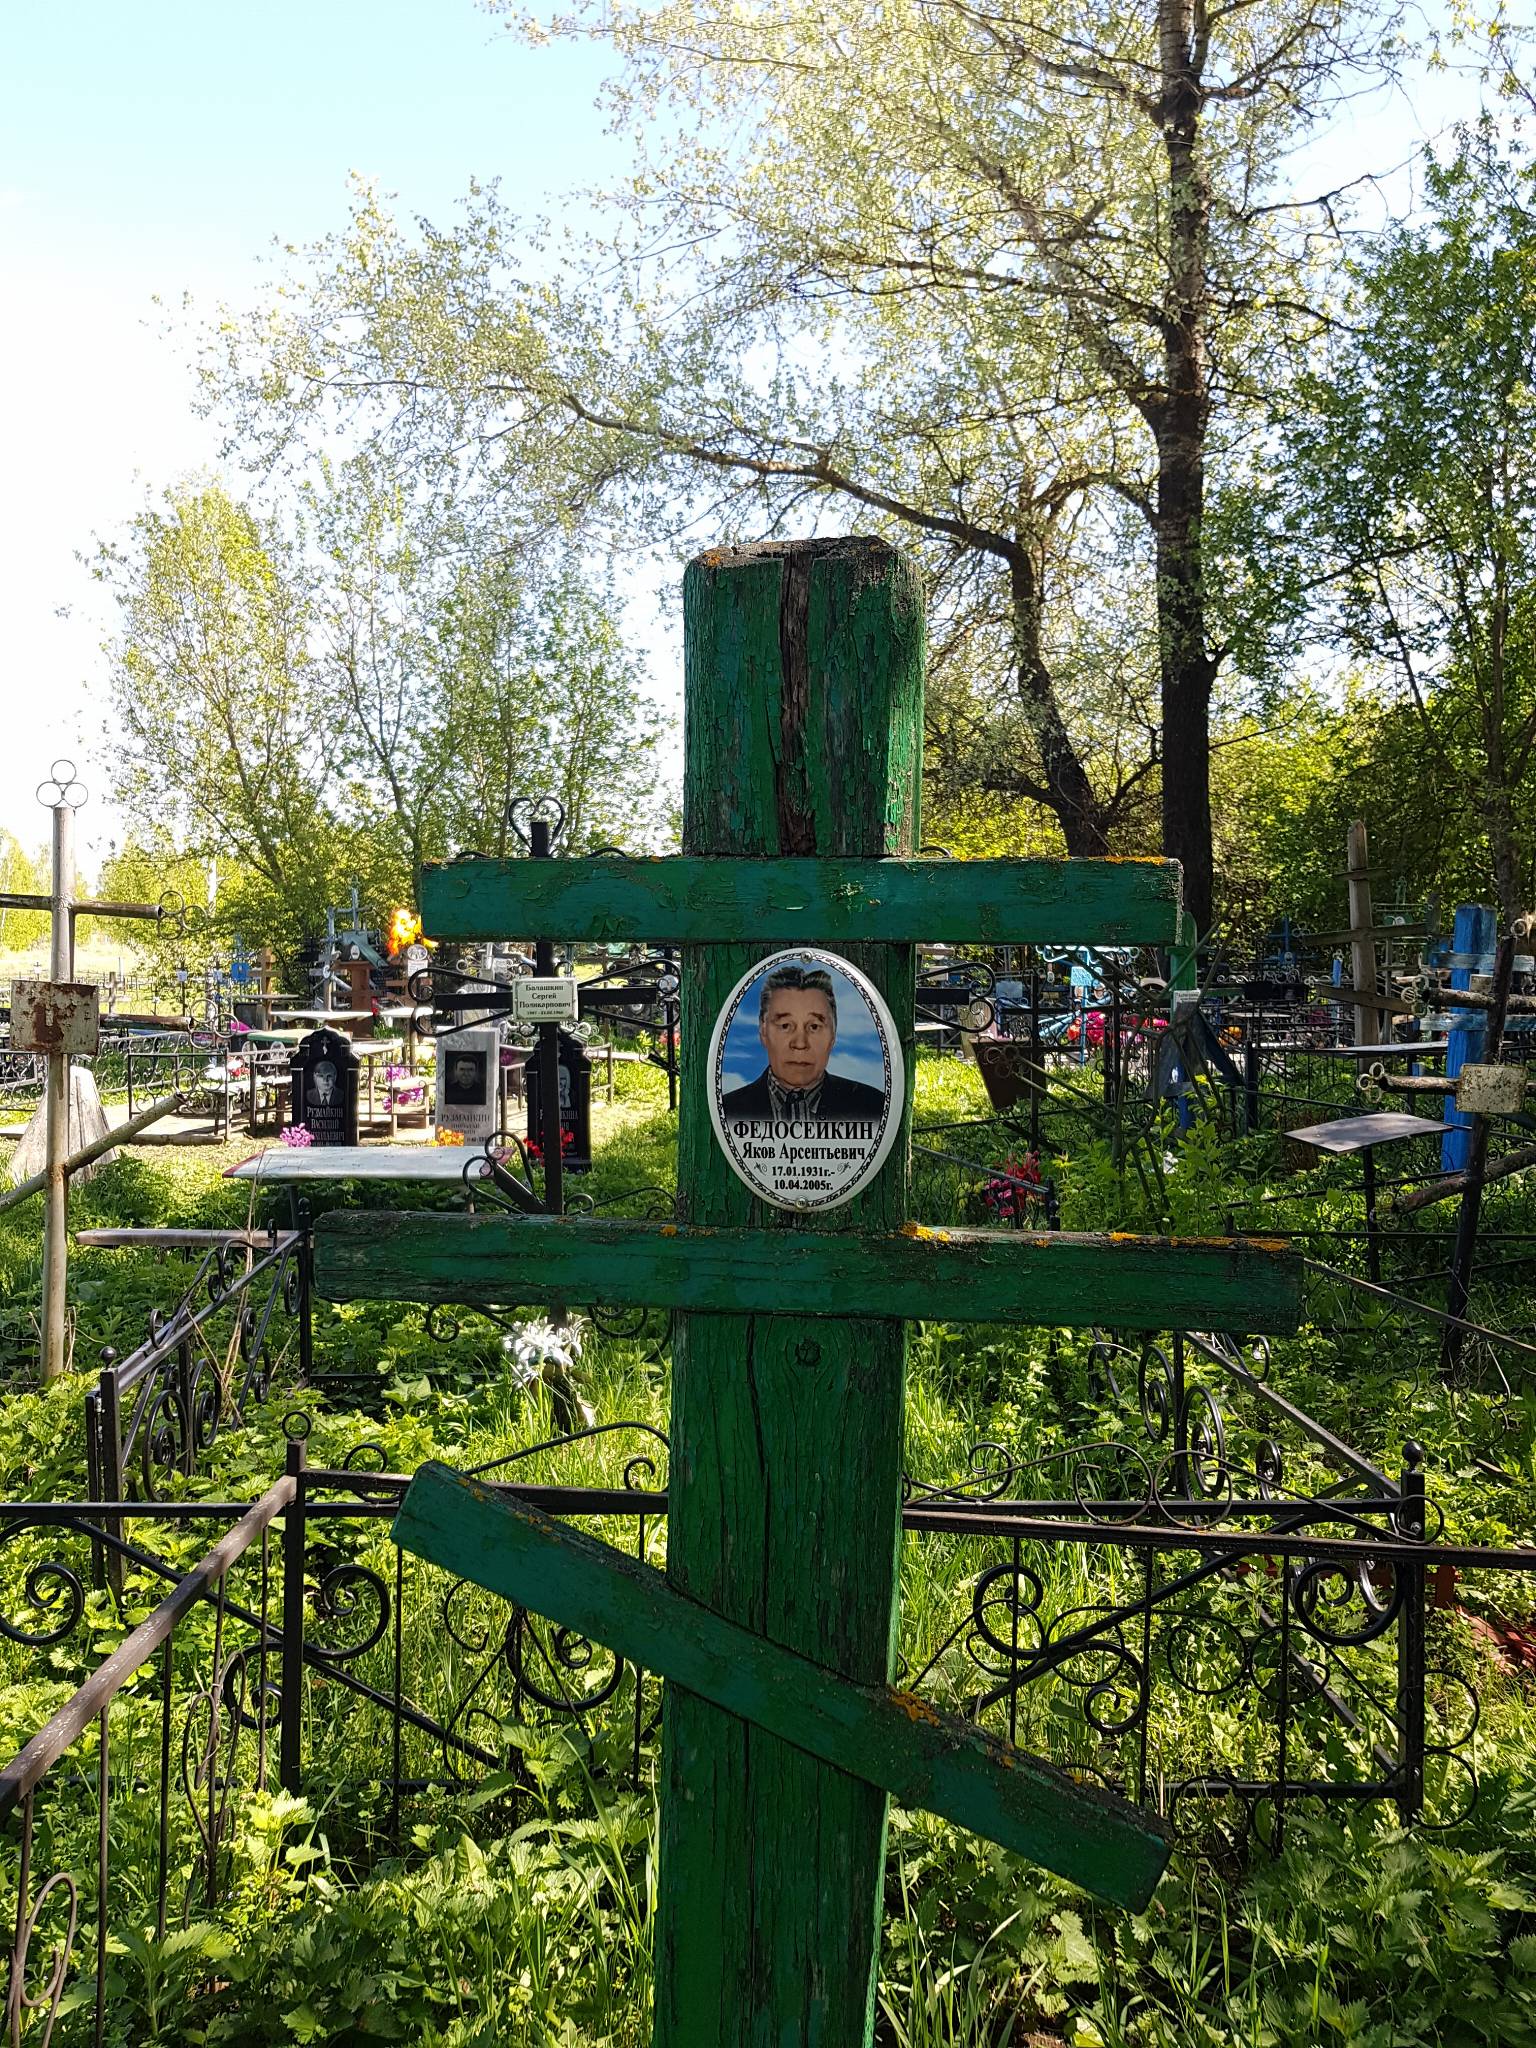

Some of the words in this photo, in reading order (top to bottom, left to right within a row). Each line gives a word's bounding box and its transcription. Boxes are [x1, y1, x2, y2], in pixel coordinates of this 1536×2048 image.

[531, 992, 557, 1000] Сергей
[519, 1001, 571, 1009] Поликарпович
[733, 1117, 874, 1142] ФЕДОСЕЙКИН
[742, 1141, 776, 1159] Яков
[780, 1142, 866, 1164] Арсентьевич
[774, 1180, 834, 1191] 10.04.2005г.
